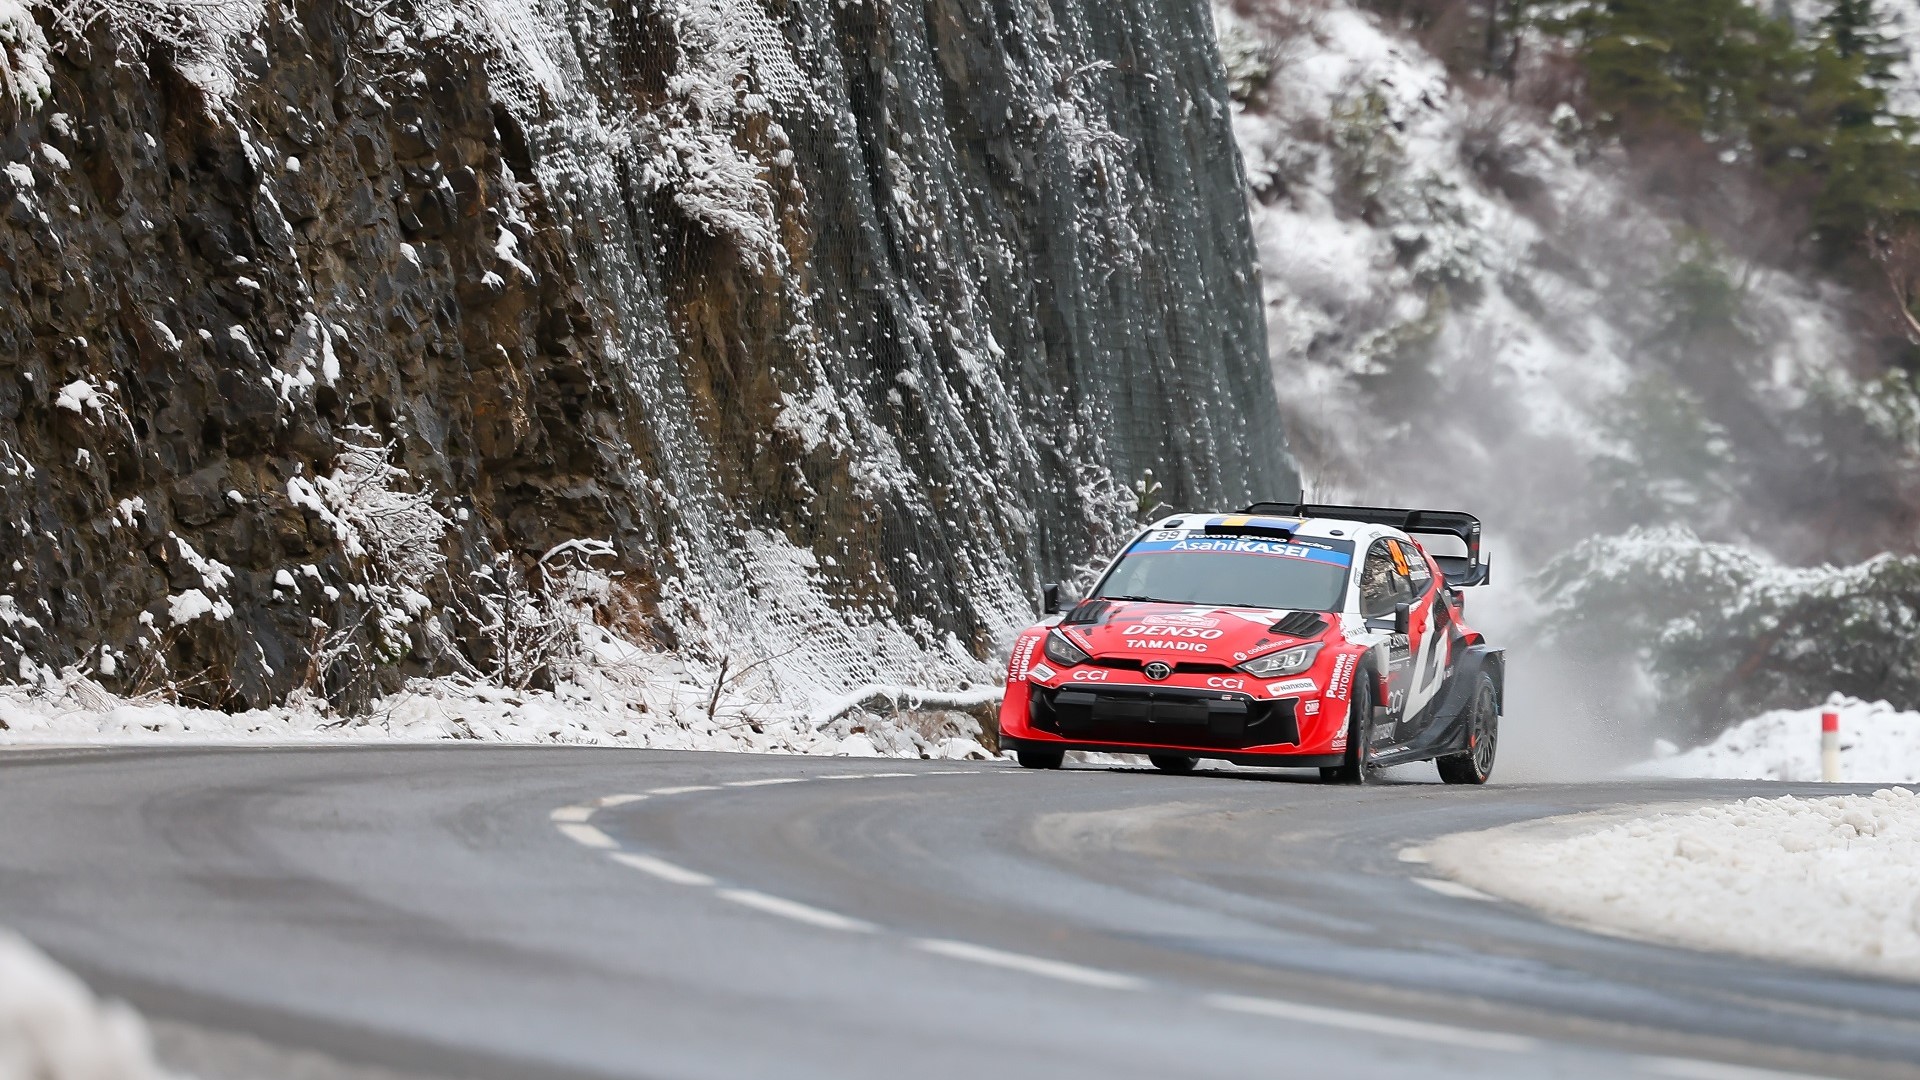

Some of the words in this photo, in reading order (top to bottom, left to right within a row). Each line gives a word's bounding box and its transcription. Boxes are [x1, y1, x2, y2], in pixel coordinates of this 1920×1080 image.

[1156, 531, 1179, 540] 99
[1239, 534, 1288, 543] GAZOO
[1170, 540, 1310, 557] AsahiKASEI
[1122, 625, 1224, 639] DENSO
[1126, 639, 1208, 652] TAMADIC
[1009, 635, 1027, 683] AUTOMOTIVE
[1019, 635, 1041, 681] Panasonic
[1326, 653, 1347, 698] Panasonic
[1338, 654, 1358, 701] AUTOMOTIVE
